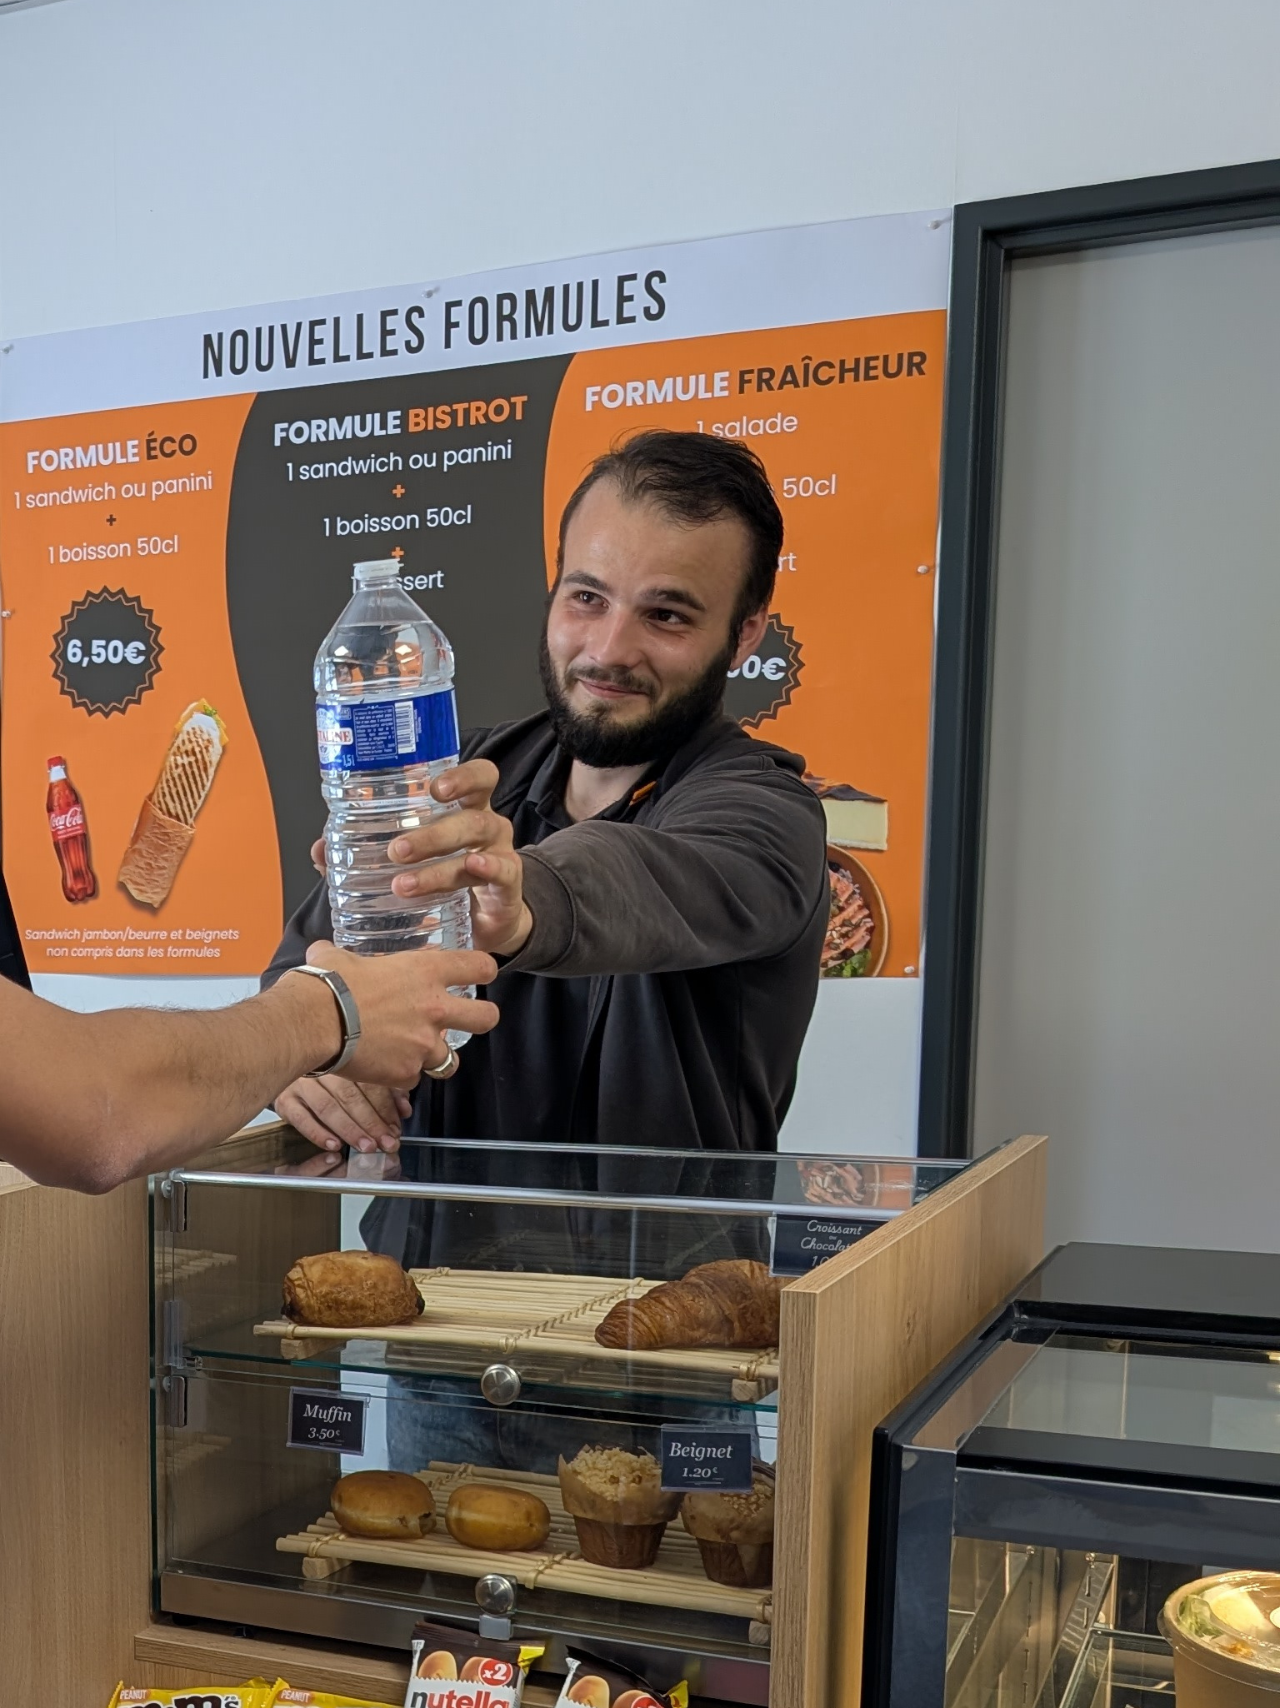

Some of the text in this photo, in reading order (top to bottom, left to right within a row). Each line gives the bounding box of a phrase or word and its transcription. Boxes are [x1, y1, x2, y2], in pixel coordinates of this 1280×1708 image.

[202, 270, 668, 379] NOUVELLES FORMULES
[585, 350, 927, 412] FORMULE FRAÎCHEUR
[274, 395, 528, 447] FORMULE BISTROT
[712, 412, 798, 439] salade
[26, 430, 198, 474] FORMULE ÉCO
[286, 438, 512, 482] 1 sandwich ou panini
[14, 470, 212, 510] 1 sandwich ou panini
[782, 473, 836, 499] 50cl
[323, 504, 472, 537] 1 boisson 50cl
[48, 534, 178, 564] 1 boisson 50cl
[395, 570, 445, 591] ssert
[66, 638, 146, 668] 6,50€
[25, 926, 239, 943] Sandwich jambon/beurre et beignets
[46, 945, 220, 960] non compris dans les formules
[807, 1220, 862, 1235] Croissant
[303, 1403, 352, 1423] Muffin
[669, 1441, 733, 1462] Beignet
[482, 1663, 507, 1681] x2
[120, 1689, 148, 1700] PEANUT
[280, 1690, 311, 1703] PEANUT
